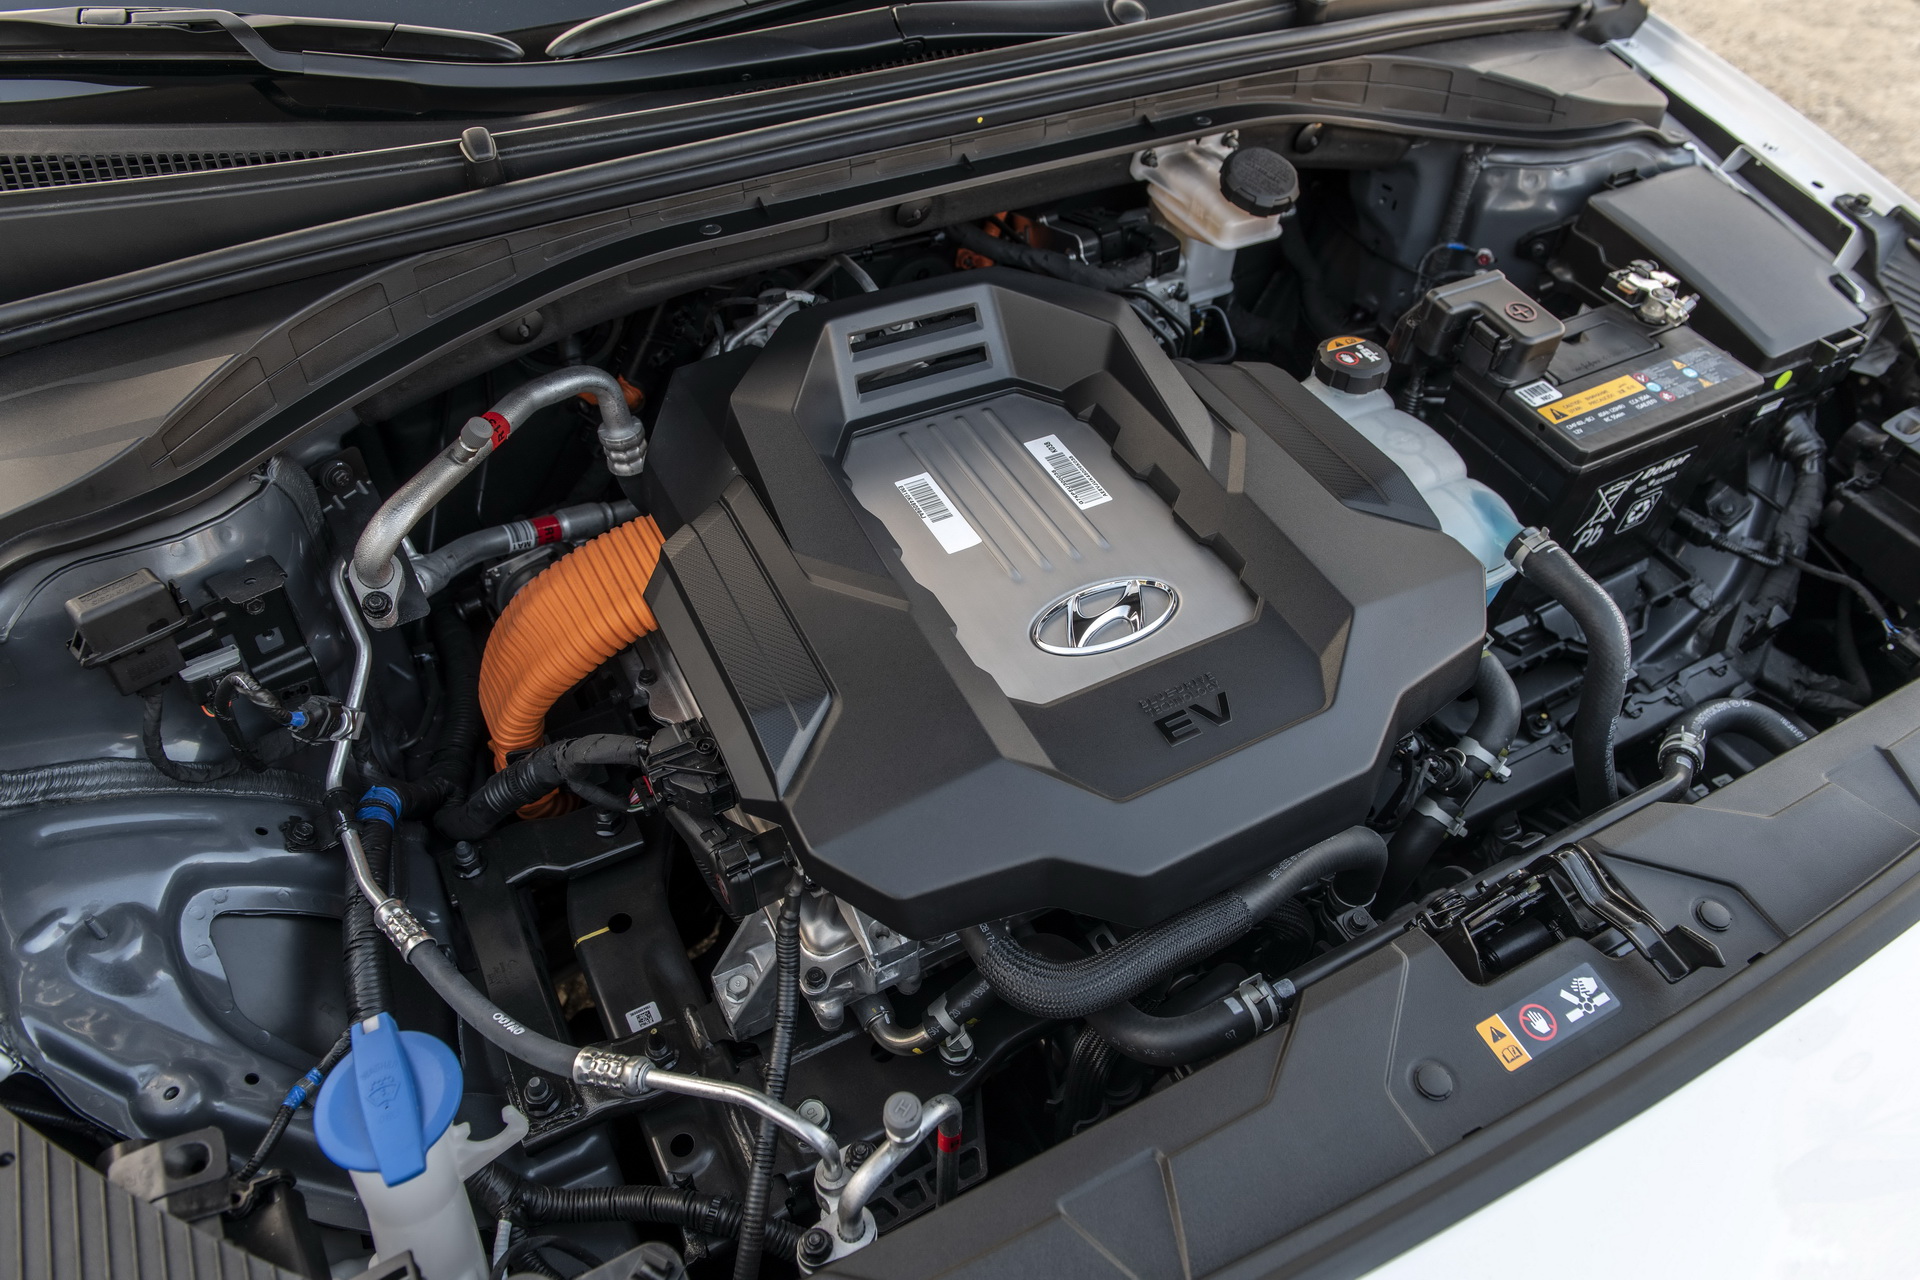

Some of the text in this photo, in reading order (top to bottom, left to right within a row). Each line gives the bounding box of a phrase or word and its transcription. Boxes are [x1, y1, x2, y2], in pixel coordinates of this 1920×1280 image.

[1572, 523, 1605, 554] Pb
[1143, 679, 1221, 718] TECHNOLOGY
[1153, 690, 1233, 748] EV
[894, 1098, 912, 1117] H
